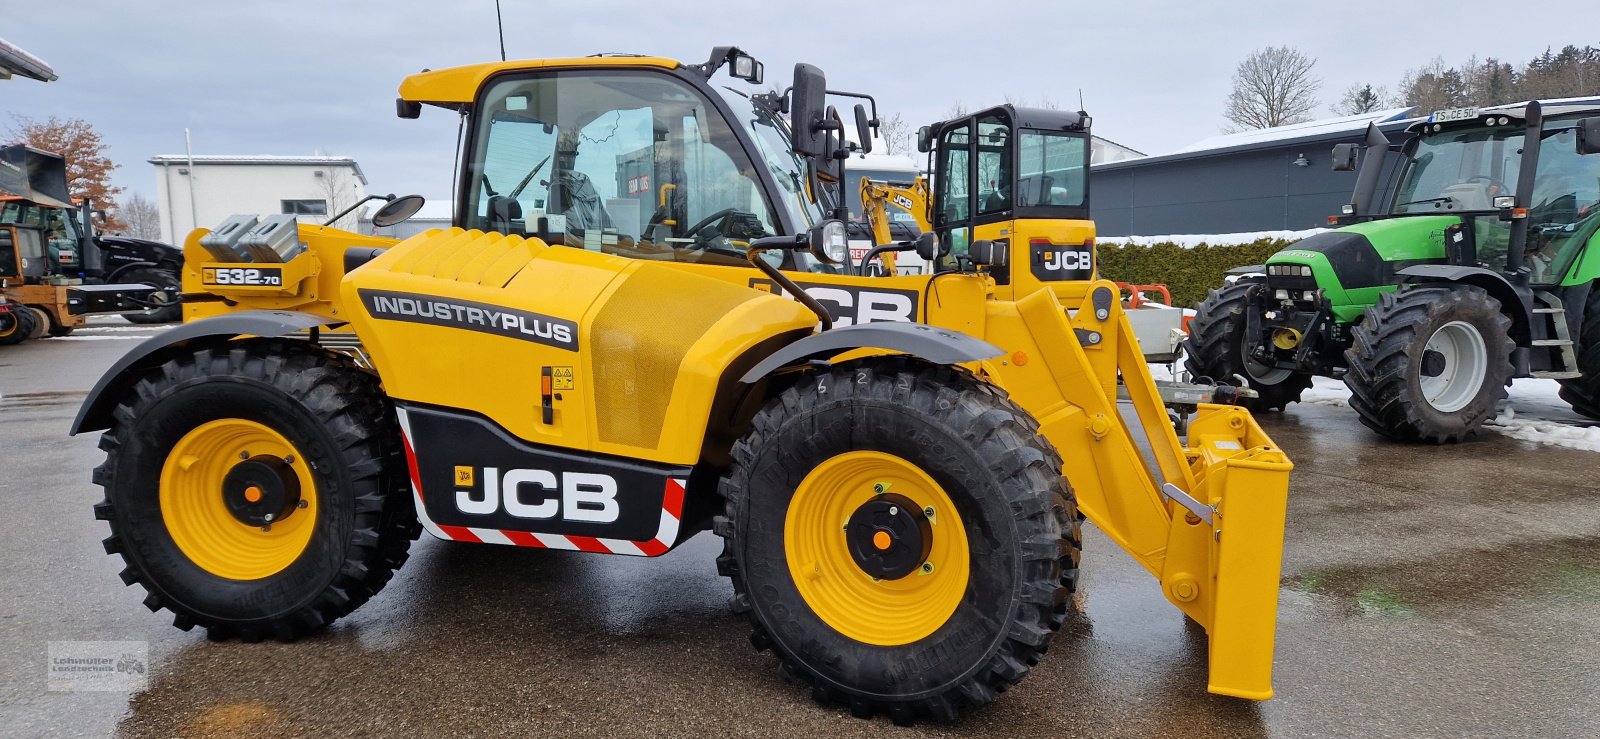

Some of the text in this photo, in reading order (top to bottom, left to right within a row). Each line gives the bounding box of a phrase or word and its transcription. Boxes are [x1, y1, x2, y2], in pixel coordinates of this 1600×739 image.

[1435, 109, 1474, 121] TS CE 50
[893, 194, 913, 209] JCB
[1045, 251, 1091, 270] JCB
[373, 296, 572, 343] INDUSTRYPLUS
[455, 467, 620, 523] JCB
